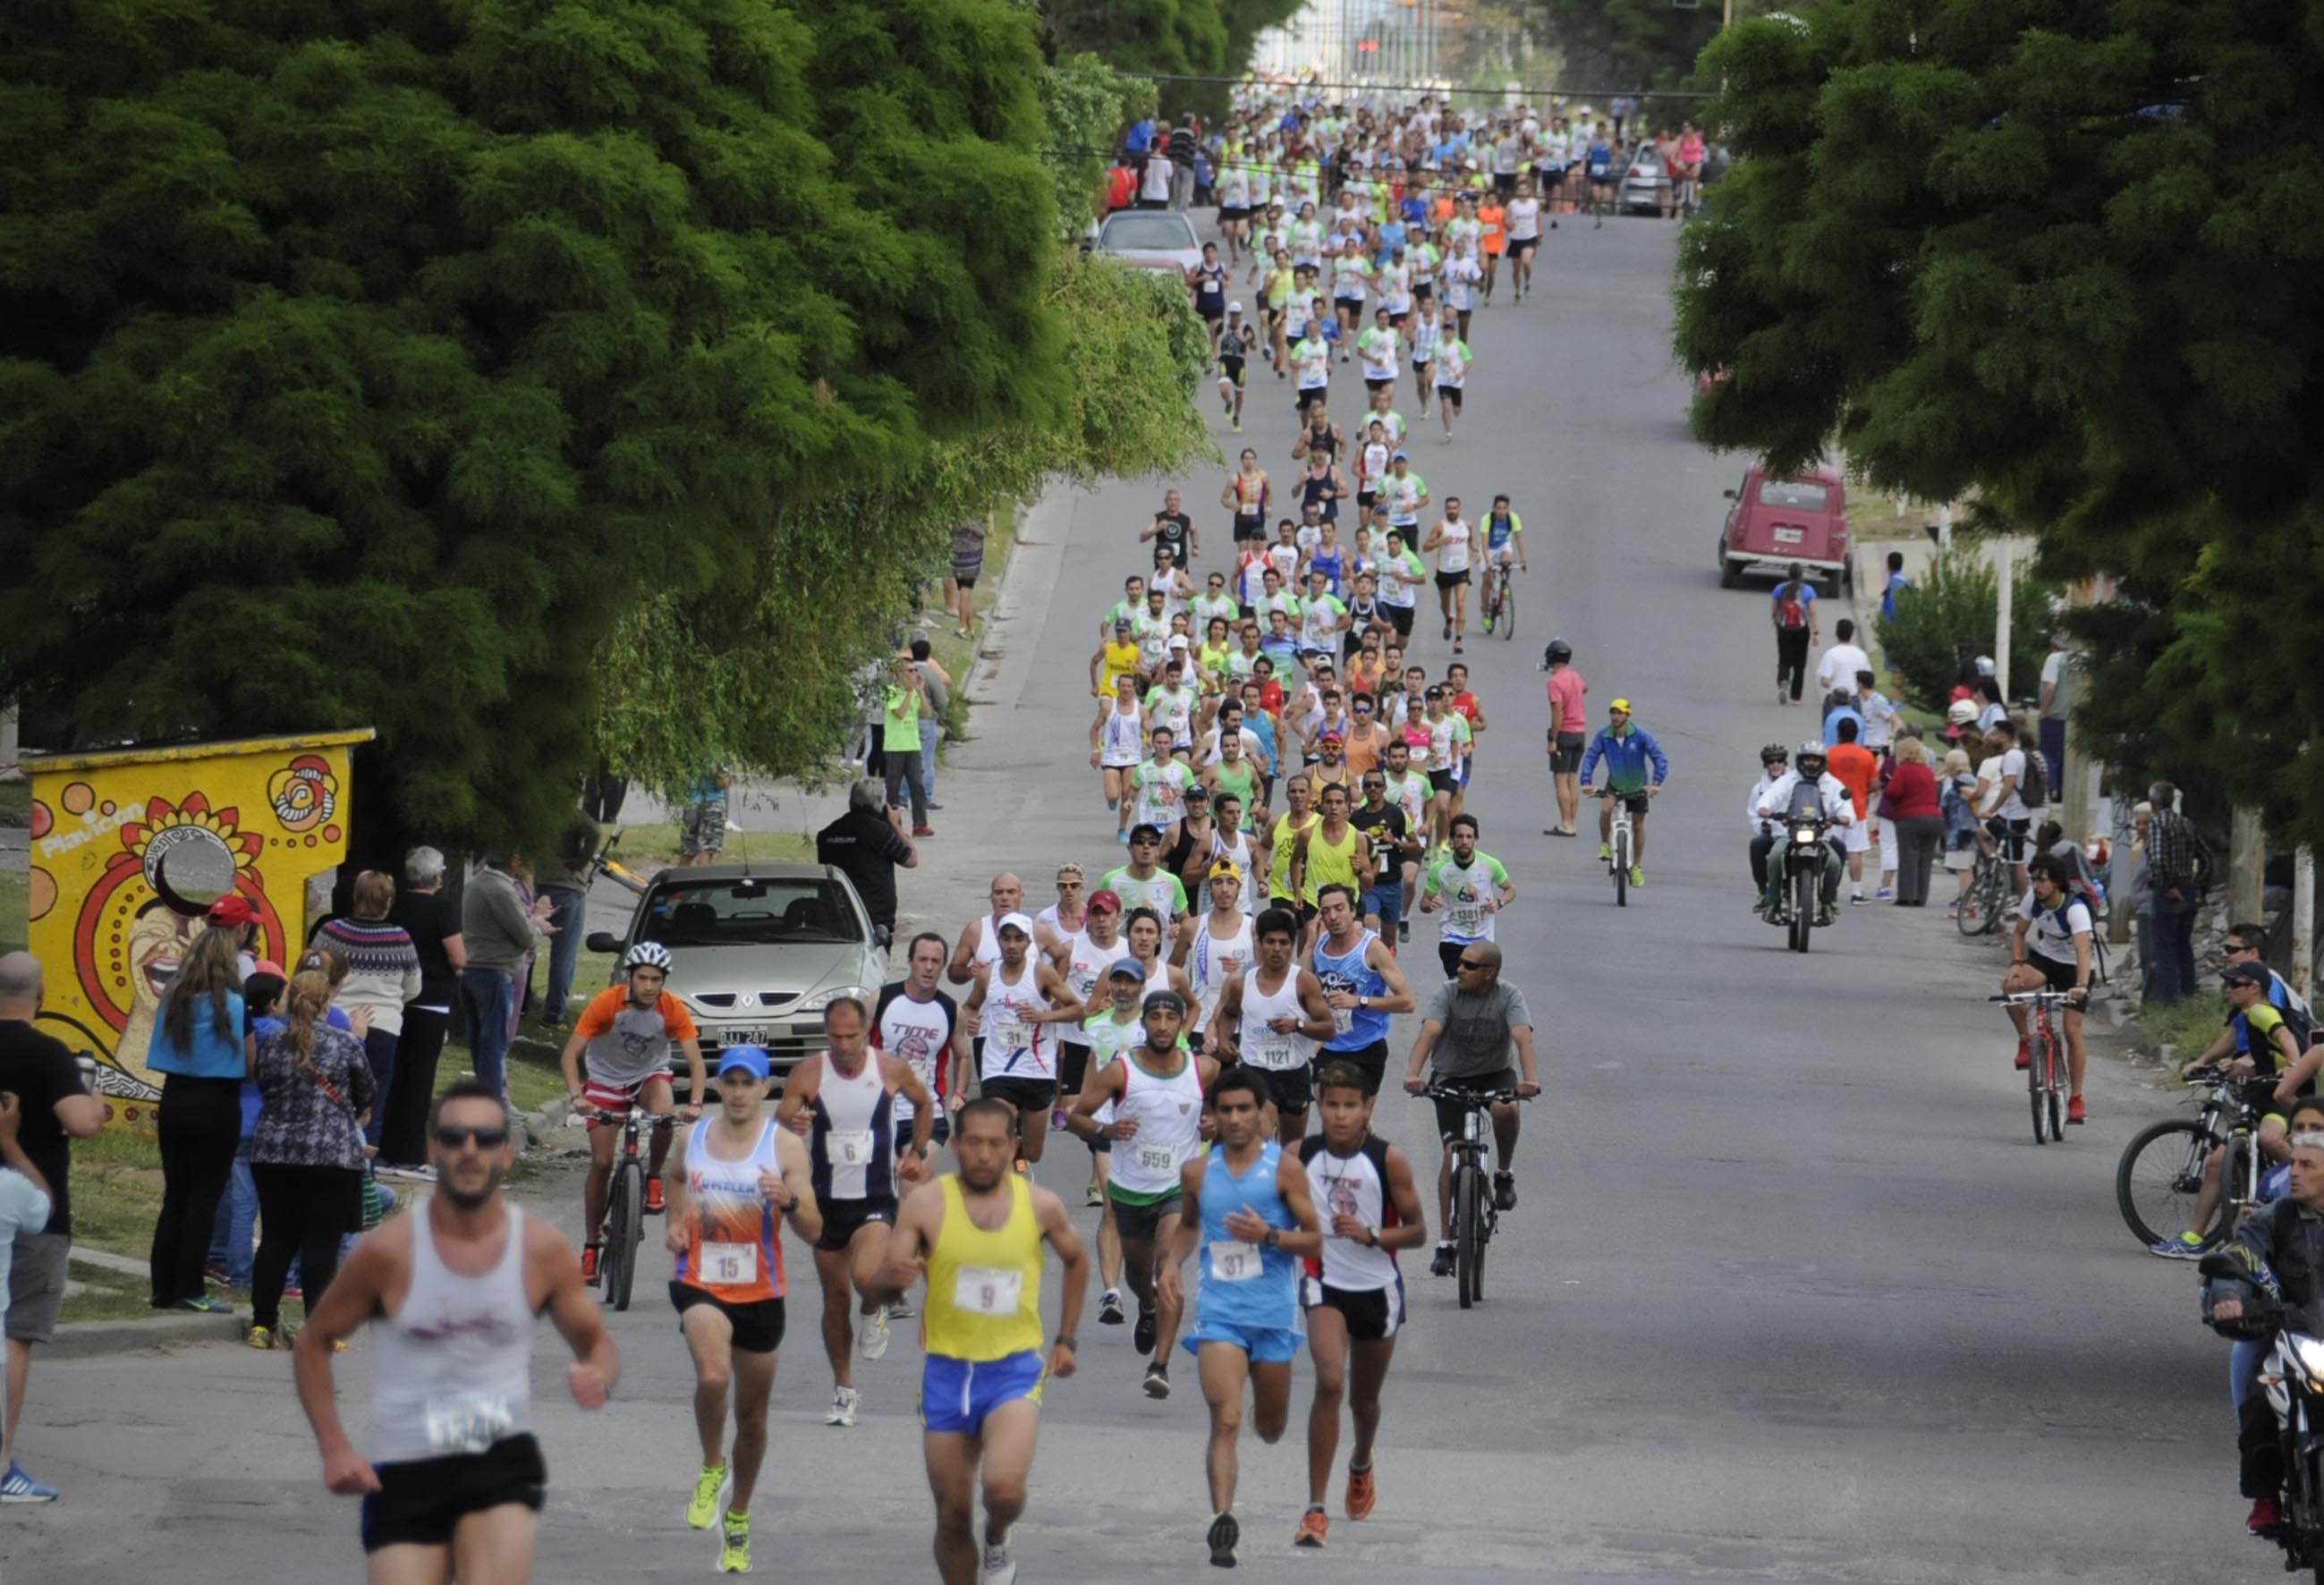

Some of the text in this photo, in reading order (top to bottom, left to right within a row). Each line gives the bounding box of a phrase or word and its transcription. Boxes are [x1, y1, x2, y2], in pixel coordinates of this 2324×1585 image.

[892, 1022, 939, 1040] TIME
[1006, 1030, 1021, 1045] 31
[1264, 1049, 1290, 1064] 1121
[844, 1144, 856, 1161] 6
[1142, 1151, 1171, 1169] 559
[718, 1257, 740, 1278] 15
[1224, 1254, 1244, 1276] 37
